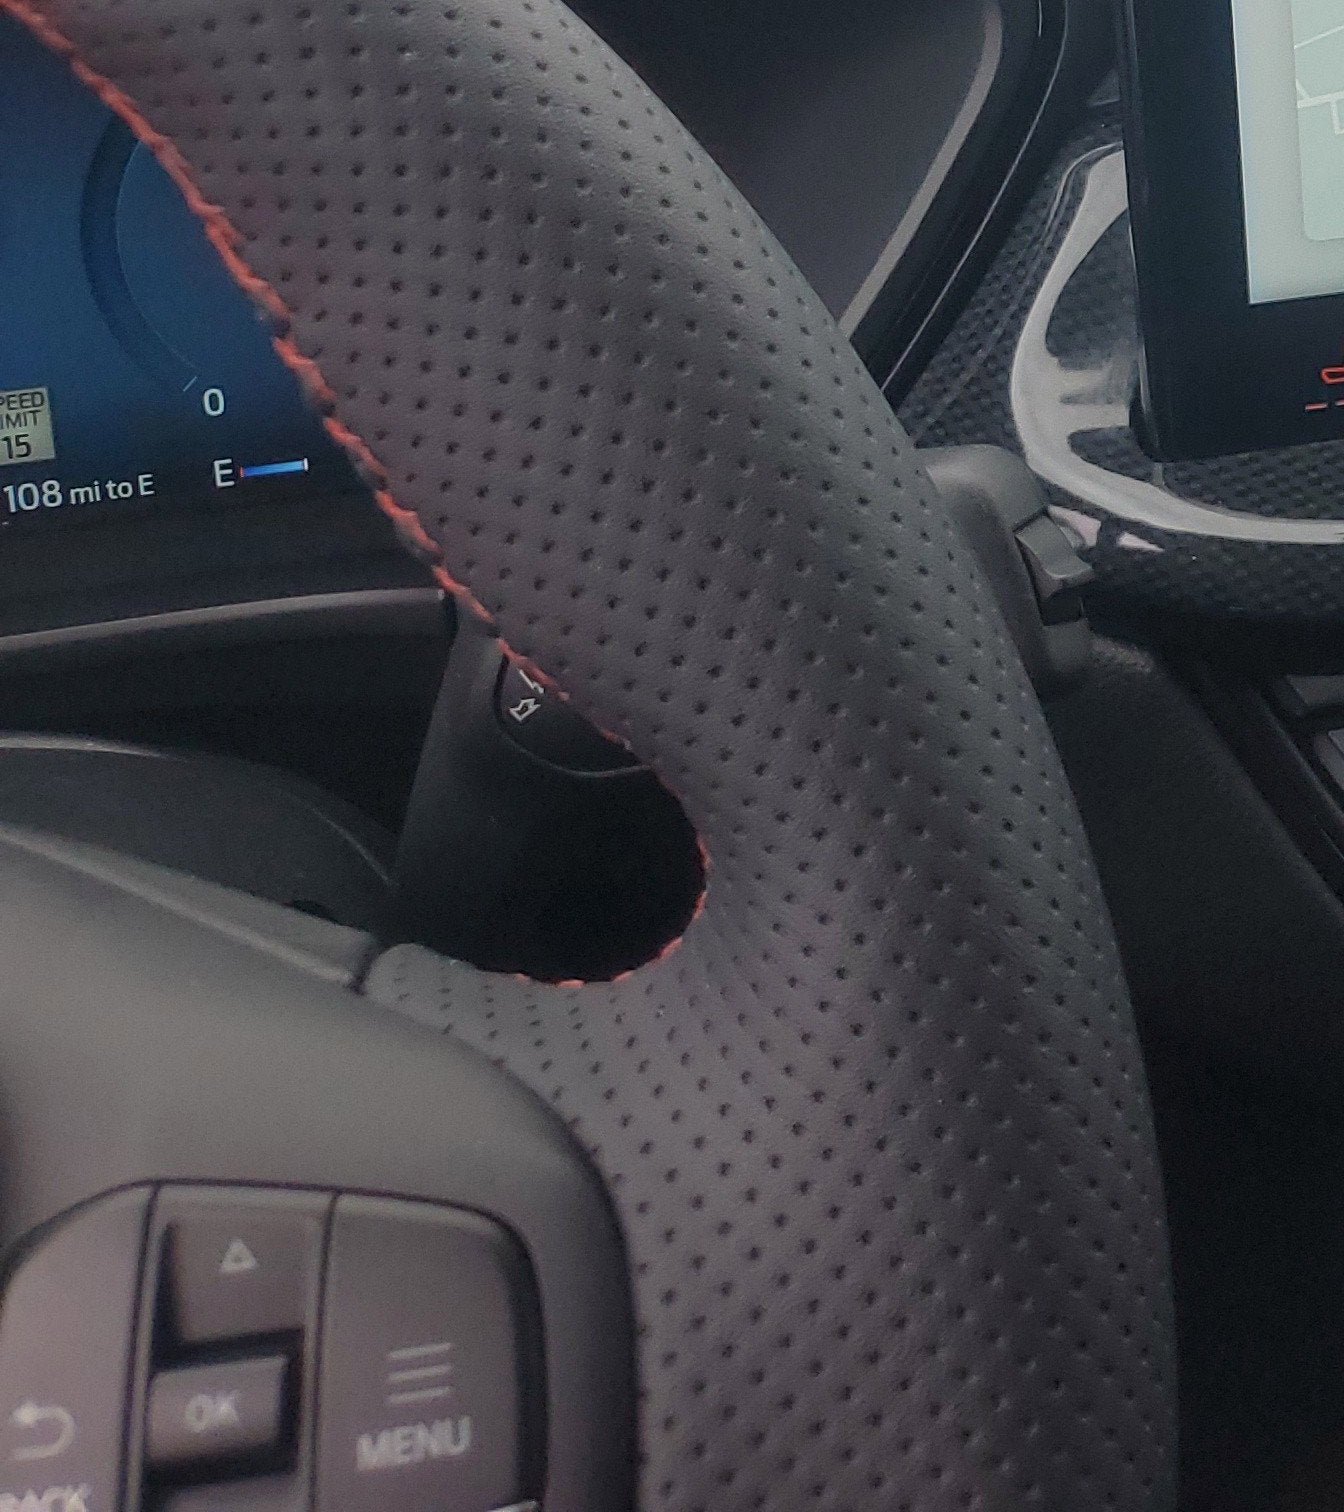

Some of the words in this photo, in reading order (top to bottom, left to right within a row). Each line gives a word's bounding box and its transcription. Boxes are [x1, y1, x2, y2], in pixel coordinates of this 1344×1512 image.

[203, 388, 225, 416] 0
[2, 433, 32, 460] 15
[213, 458, 235, 488] E
[3, 479, 63, 513] 108
[69, 480, 101, 505] mi
[105, 480, 133, 500] to
[137, 473, 155, 496] E
[184, 1392, 241, 1434] OK
[356, 1415, 472, 1472] MENU
